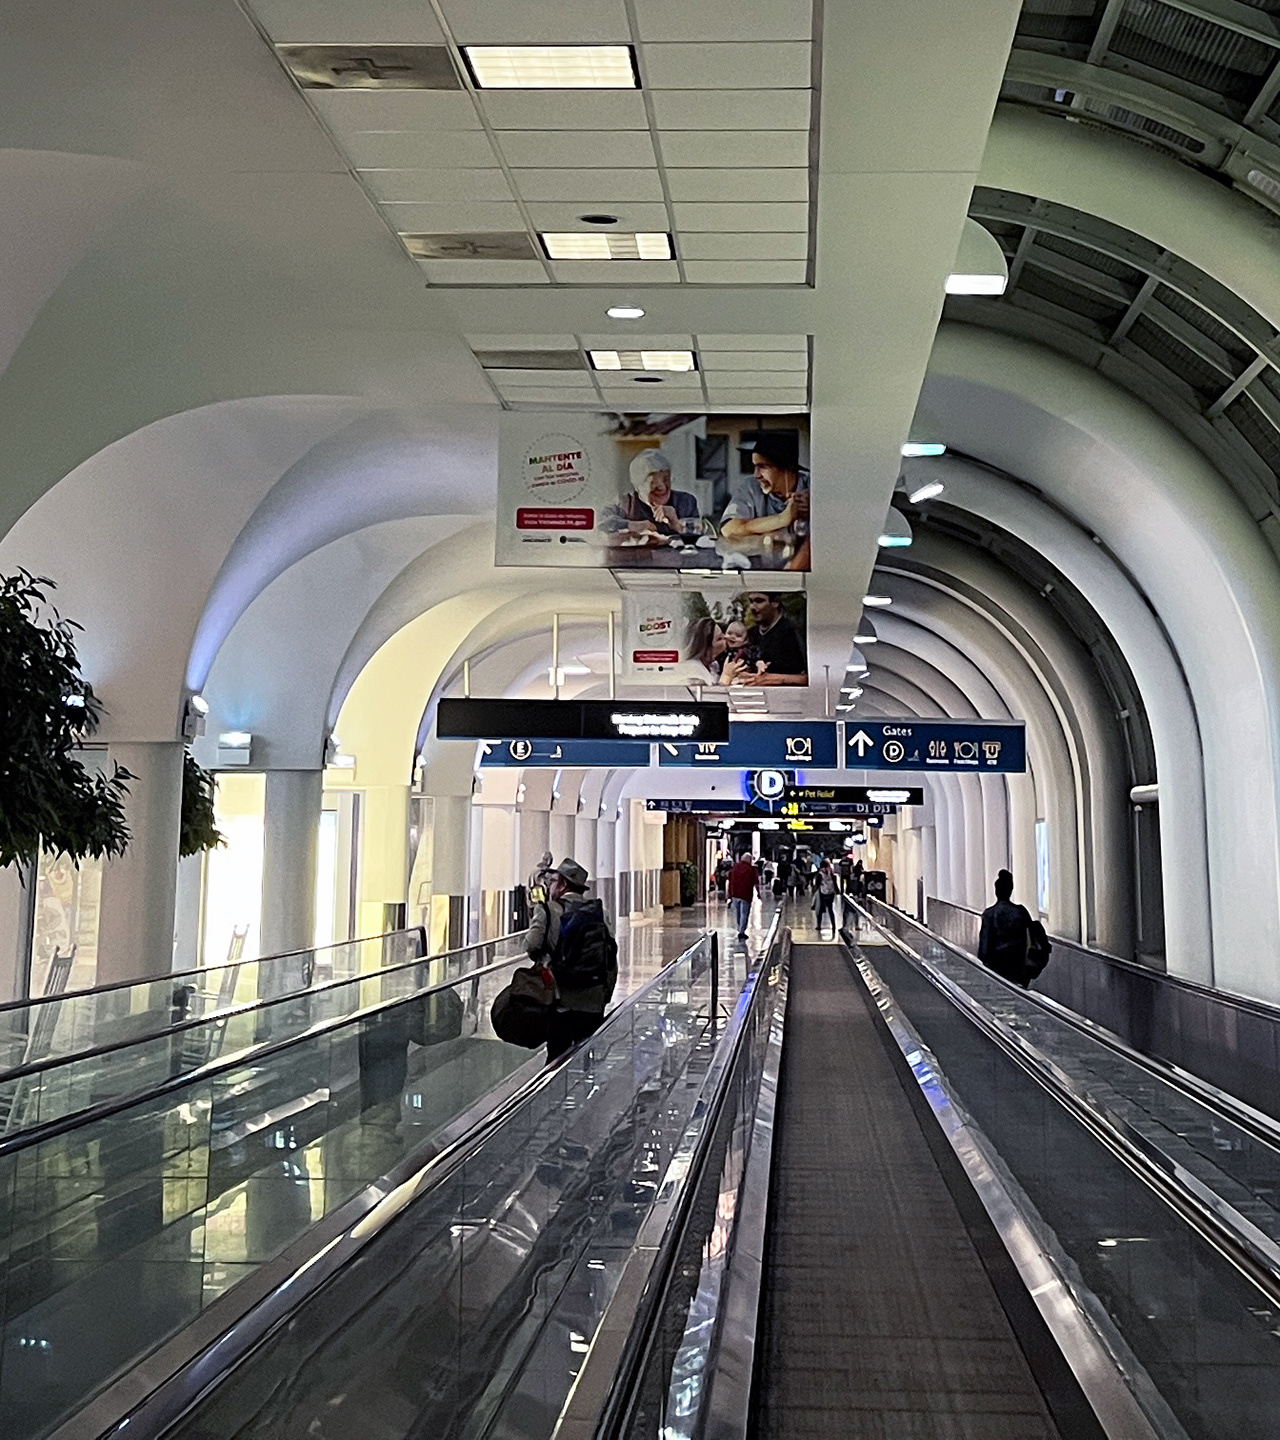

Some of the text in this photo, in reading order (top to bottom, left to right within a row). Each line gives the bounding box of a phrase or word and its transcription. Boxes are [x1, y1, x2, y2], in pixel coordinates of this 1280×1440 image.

[541, 465, 555, 473] AL
[639, 620, 672, 632] BOOST
[882, 725, 913, 737] Gates
[516, 741, 526, 754] E
[889, 745, 900, 758] D
[761, 771, 784, 795] D
[804, 789, 816, 798] Pet
